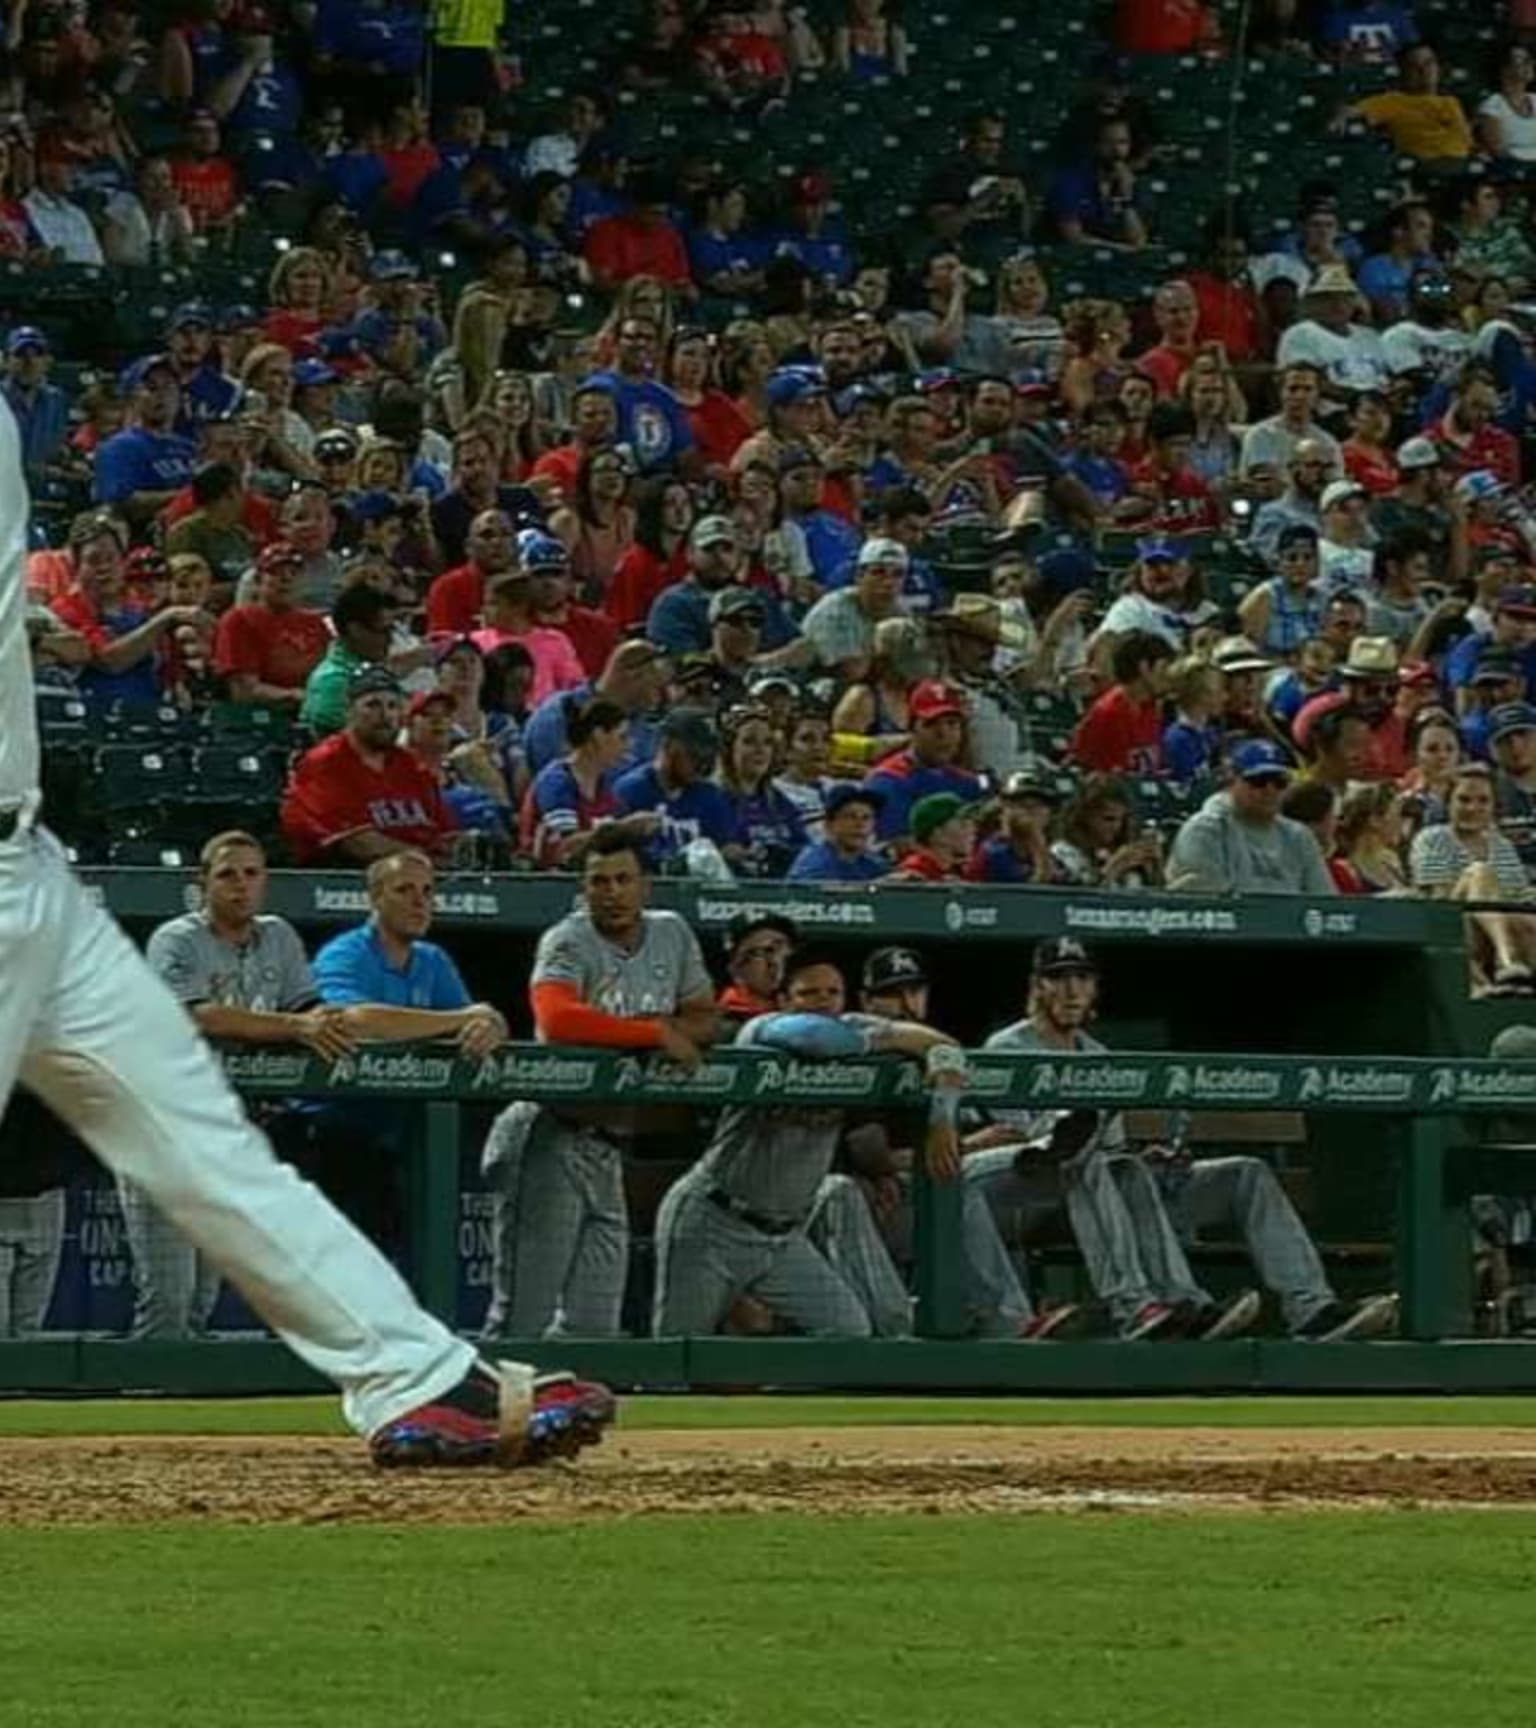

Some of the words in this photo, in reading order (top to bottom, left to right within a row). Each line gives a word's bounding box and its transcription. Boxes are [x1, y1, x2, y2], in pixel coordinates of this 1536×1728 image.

[368, 798, 429, 830] TEXA
[225, 1053, 309, 1084] cademy
[359, 1053, 454, 1085] Academy
[500, 1056, 597, 1087] Academy
[785, 1061, 879, 1092] Academy
[1060, 1064, 1149, 1095] Academy
[1195, 1065, 1283, 1097] Academy
[1327, 1067, 1414, 1099] Academy
[1458, 1069, 1536, 1095] Academ
